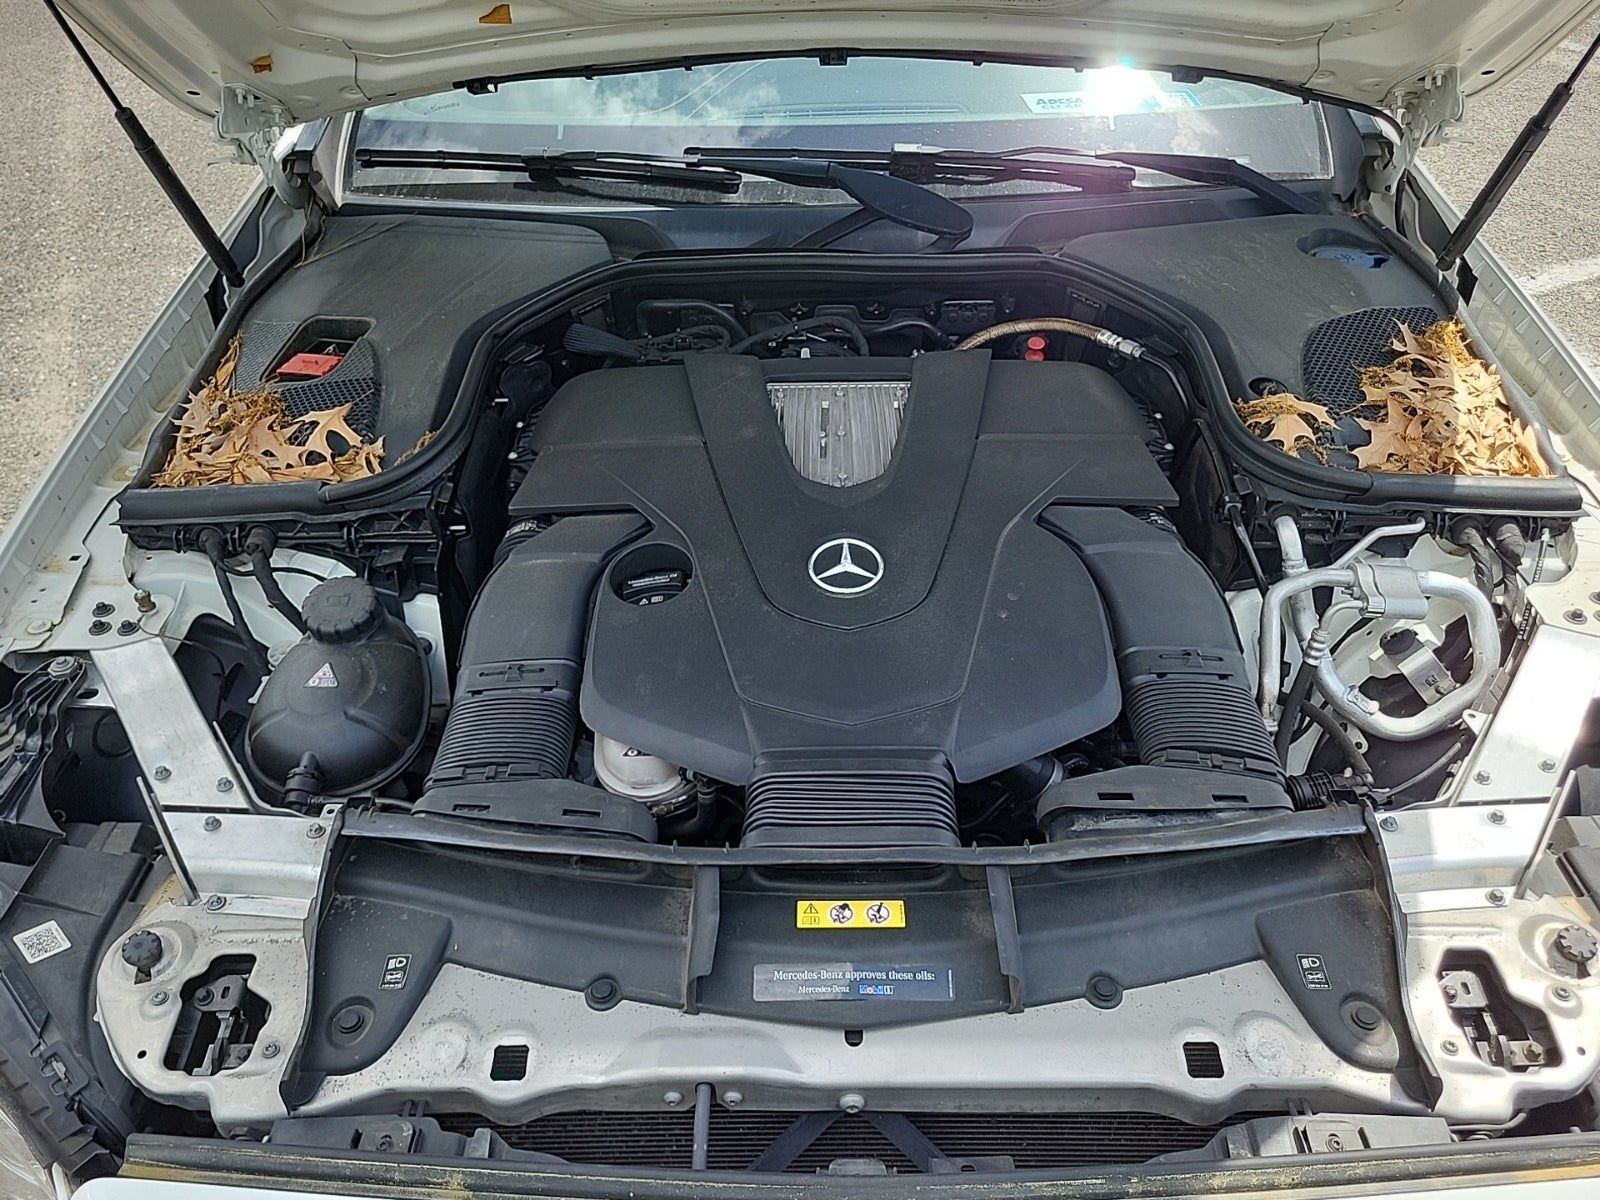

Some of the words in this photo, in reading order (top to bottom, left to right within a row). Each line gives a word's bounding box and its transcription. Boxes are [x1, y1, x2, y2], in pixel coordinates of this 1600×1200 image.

[773, 970, 844, 980] Mercedes-Benz
[845, 970, 887, 981] approves
[888, 970, 914, 980] these
[915, 970, 936, 980] oils:
[798, 985, 850, 994] Mercedes-Benz
